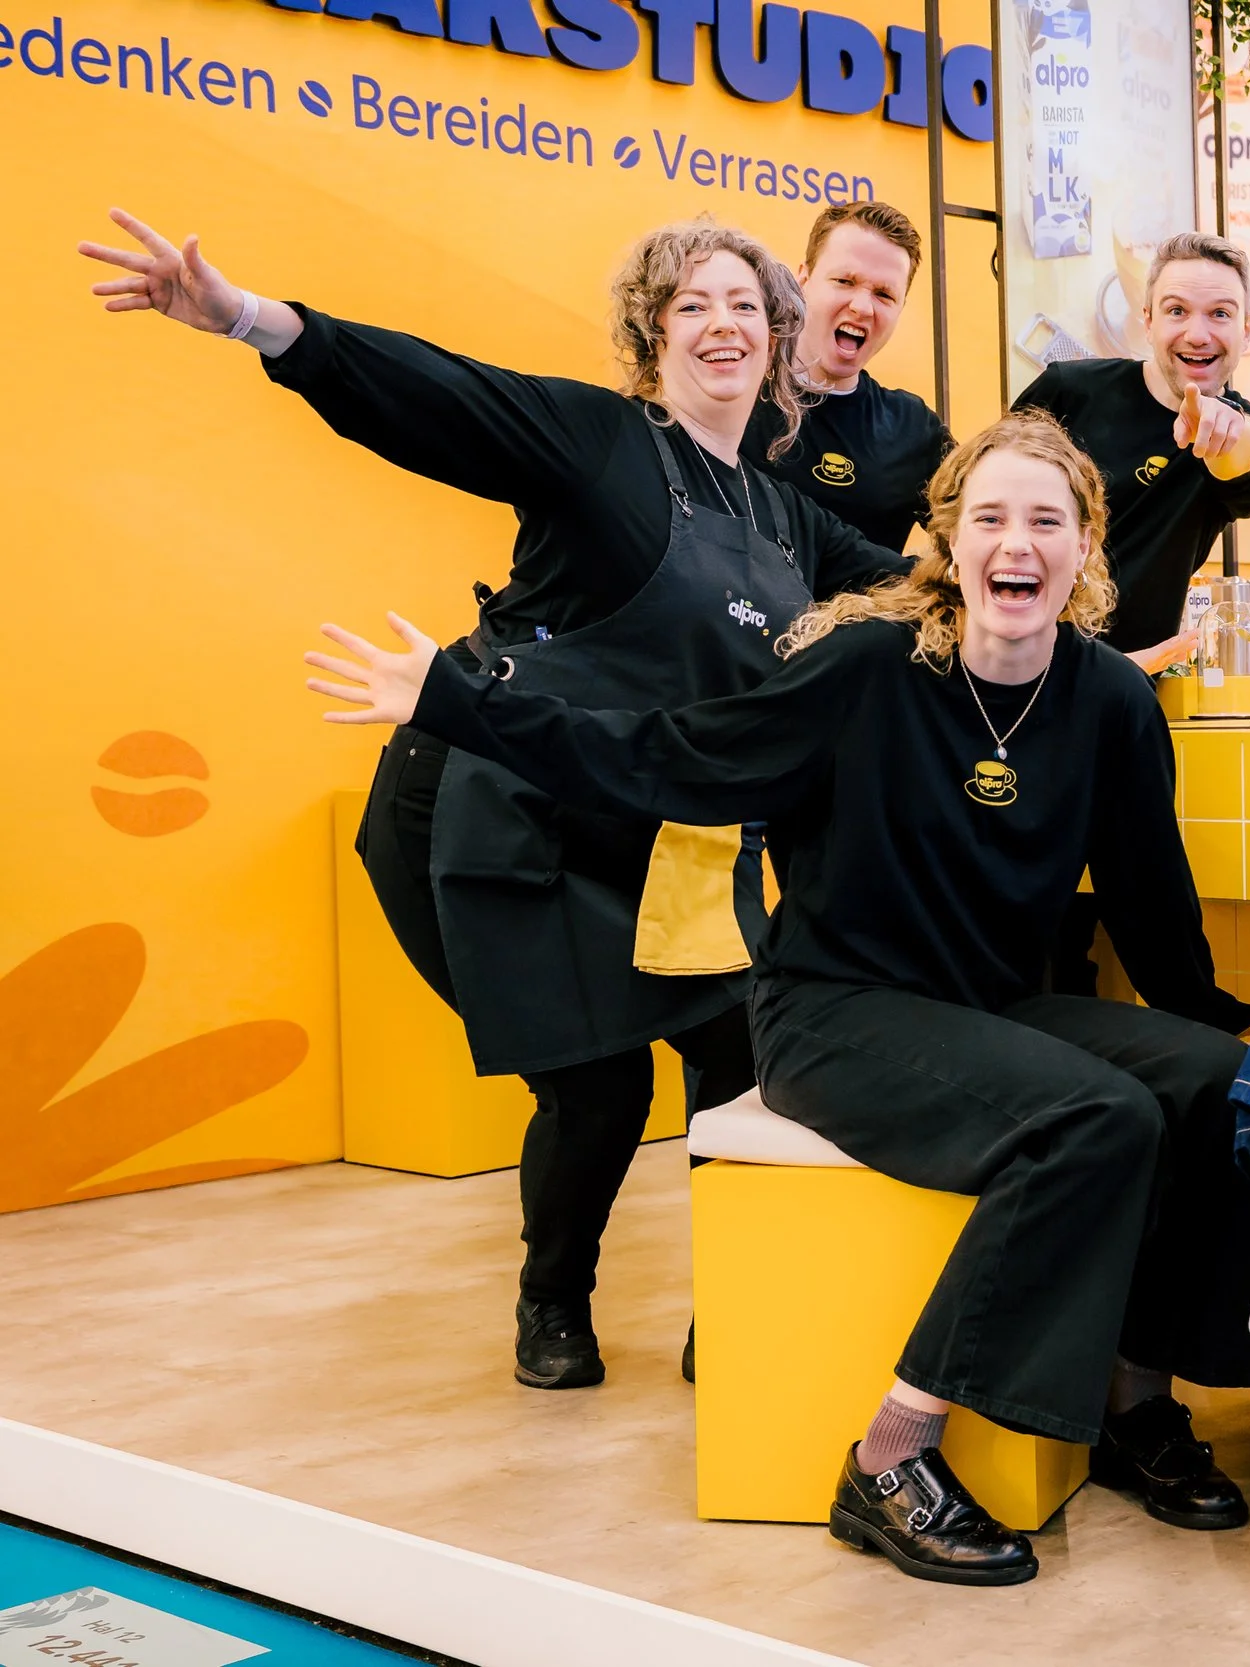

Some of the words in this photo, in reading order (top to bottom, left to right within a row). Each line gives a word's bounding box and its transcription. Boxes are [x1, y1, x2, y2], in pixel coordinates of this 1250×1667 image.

[262, 0, 993, 143] STUDIO
[1036, 54, 1089, 95] alpro
[1042, 105, 1084, 122] BARISTA
[351, 73, 593, 167] Bereiden
[653, 129, 874, 207] Verrassen
[1059, 130, 1079, 145] NOT
[728, 598, 766, 627] alpro
[1189, 593, 1210, 608] alpro
[979, 777, 1003, 790] alpro
[81, 1619, 125, 1635] Hal
[113, 1631, 146, 1644] 12
